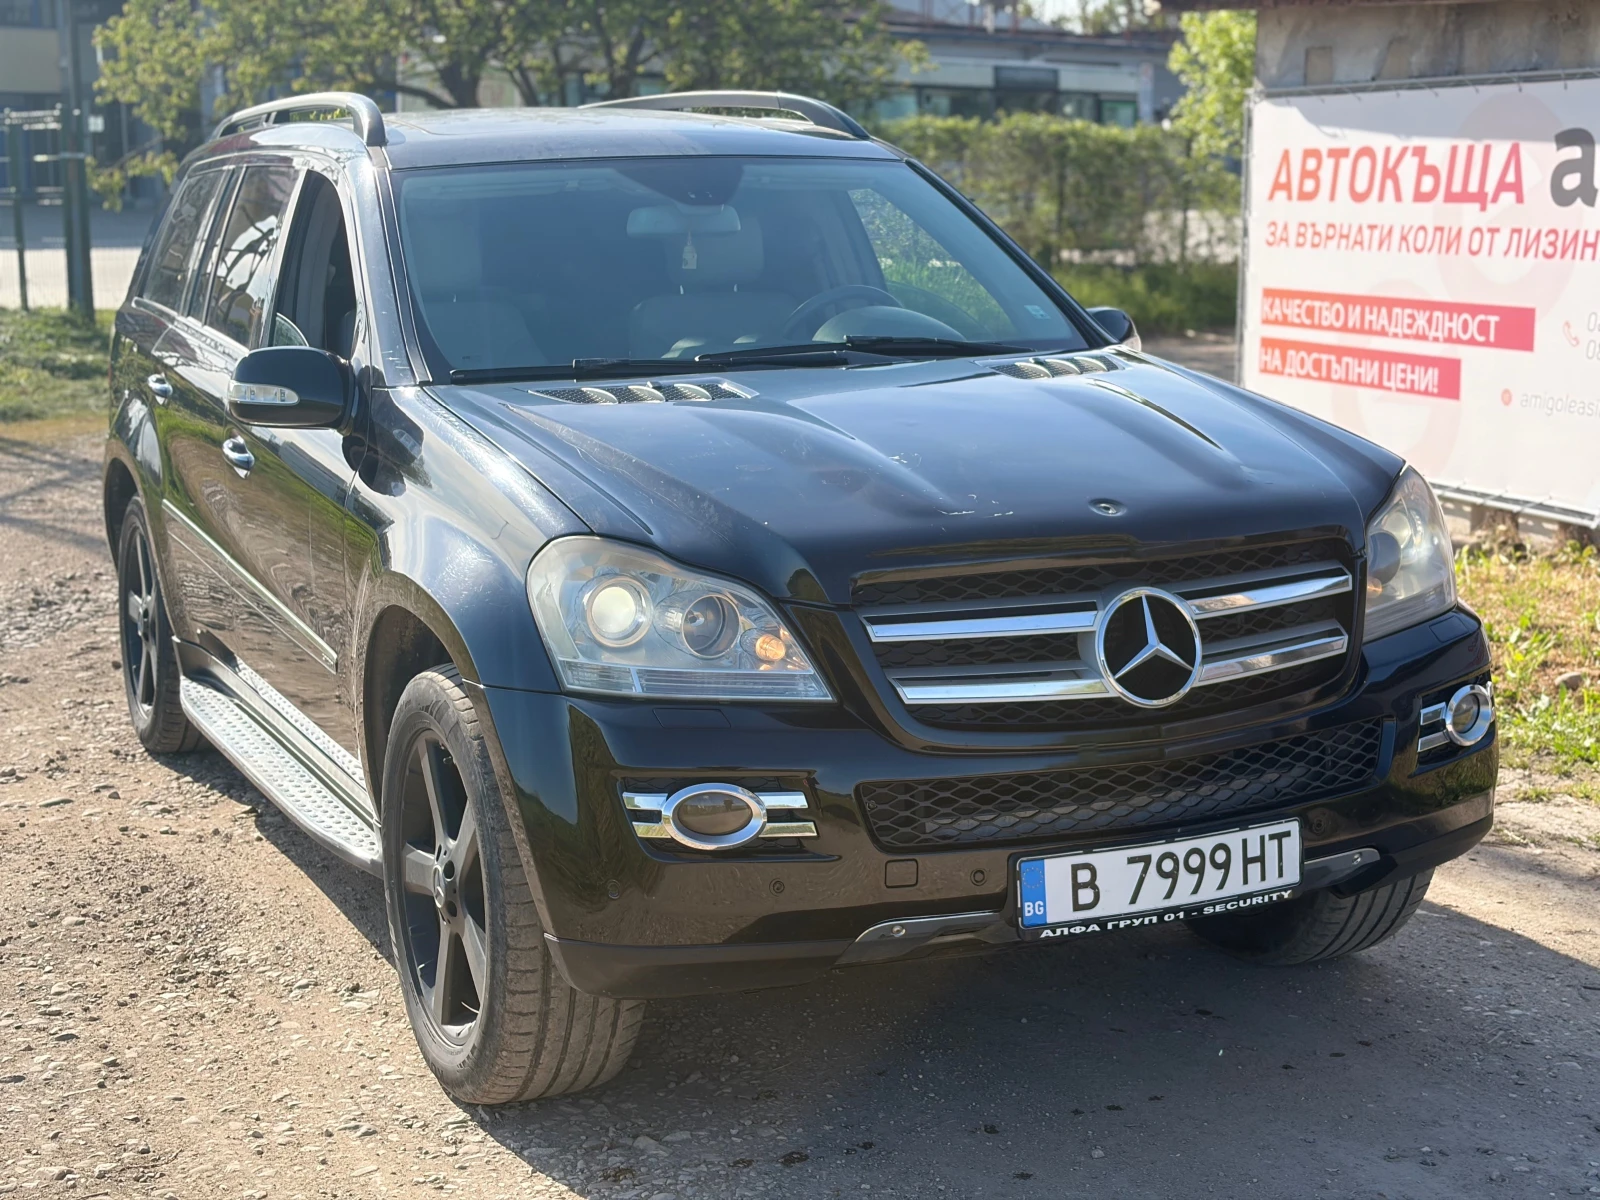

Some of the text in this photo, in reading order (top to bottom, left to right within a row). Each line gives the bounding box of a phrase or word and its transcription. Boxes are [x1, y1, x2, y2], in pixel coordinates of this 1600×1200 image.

[1268, 142, 1525, 212] АВТОКЪЩА
[1265, 220, 1600, 261] ЗА ВЪРНАТИ КОЛИ ОТ ЛИЗИН
[1262, 296, 1500, 342] КАЧЕСТВО И НАДЕЖДНОСТ
[1260, 346, 1439, 393] НА ДОСТЪПНИ ЦЕНИ!
[1520, 391, 1600, 417] amigoleasi
[1126, 842, 1232, 905] 7999
[1024, 900, 1045, 917] BG
[1039, 924, 1101, 939] АЛФА
[1107, 915, 1158, 930] ГРУП
[1164, 911, 1185, 922] 01
[1202, 889, 1293, 915] SECURITY
